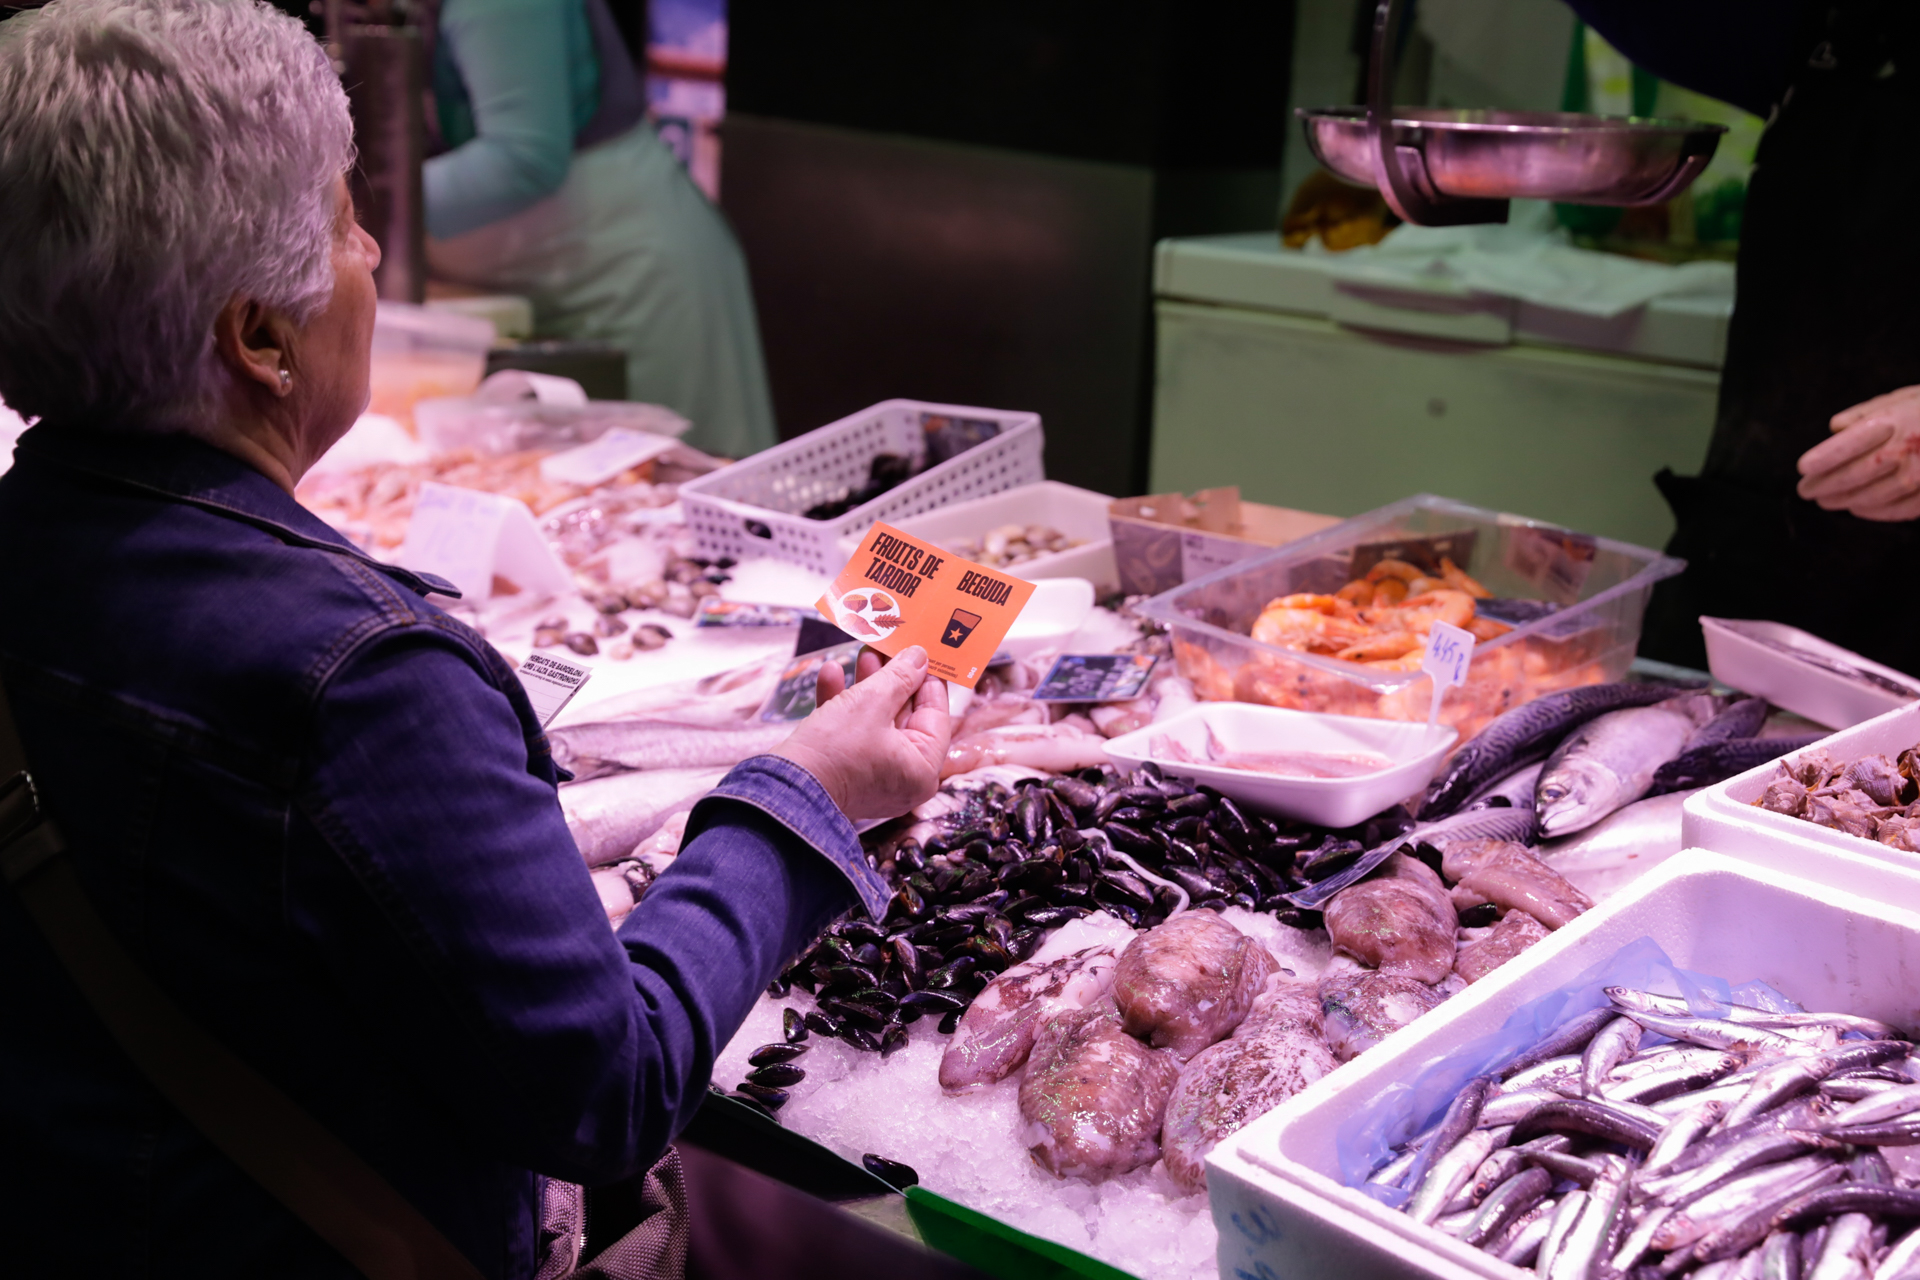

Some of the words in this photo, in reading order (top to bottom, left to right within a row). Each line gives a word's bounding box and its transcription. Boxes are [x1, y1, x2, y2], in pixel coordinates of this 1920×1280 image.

[869, 532, 925, 571] FRUITS
[918, 554, 945, 580] DE
[864, 557, 922, 598] TARDOR
[956, 569, 1014, 607] BEGUDA
[522, 661, 535, 670] AMB
[528, 654, 551, 666] MERCATS
[548, 660, 558, 669] DE
[555, 663, 585, 678] BARCELONA
